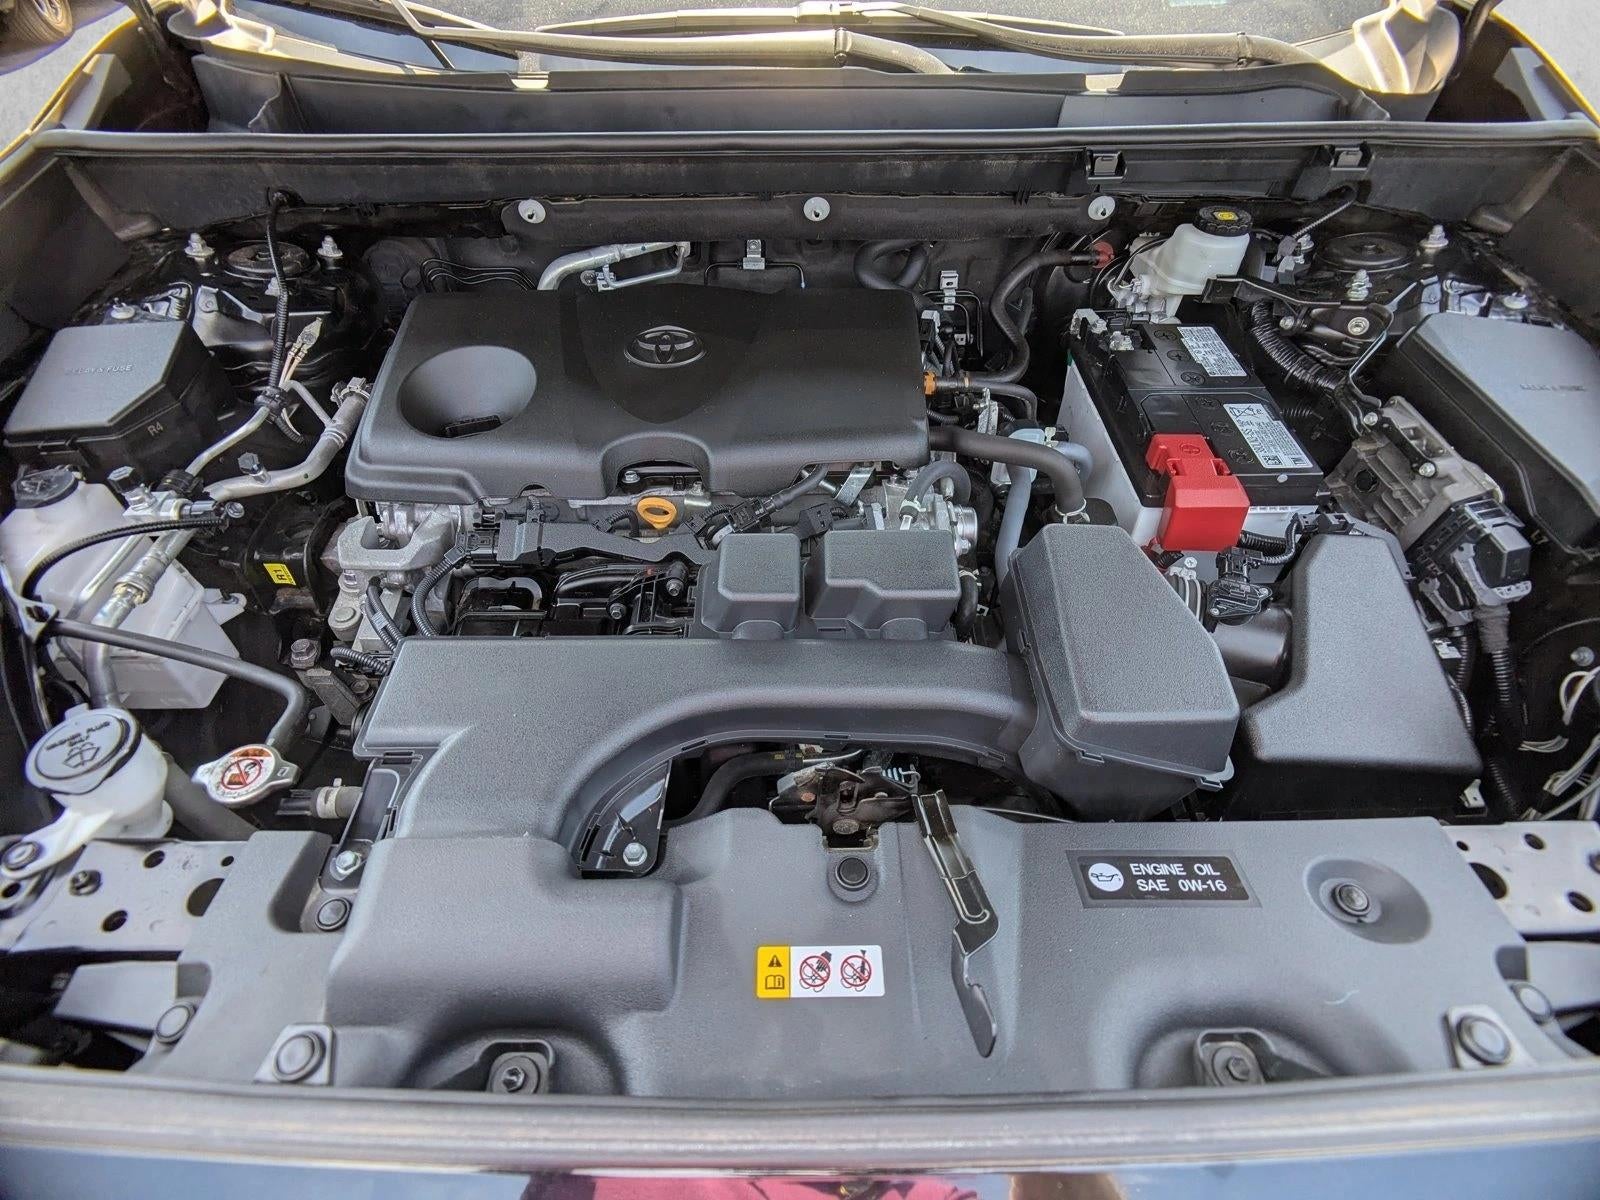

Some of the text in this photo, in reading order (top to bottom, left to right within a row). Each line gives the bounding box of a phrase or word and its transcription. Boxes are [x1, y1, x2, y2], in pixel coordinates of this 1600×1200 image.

[147, 421, 164, 437] R4
[1129, 863, 1221, 876] ENGINE OIL
[1136, 879, 1228, 893] SAE 0W-16
